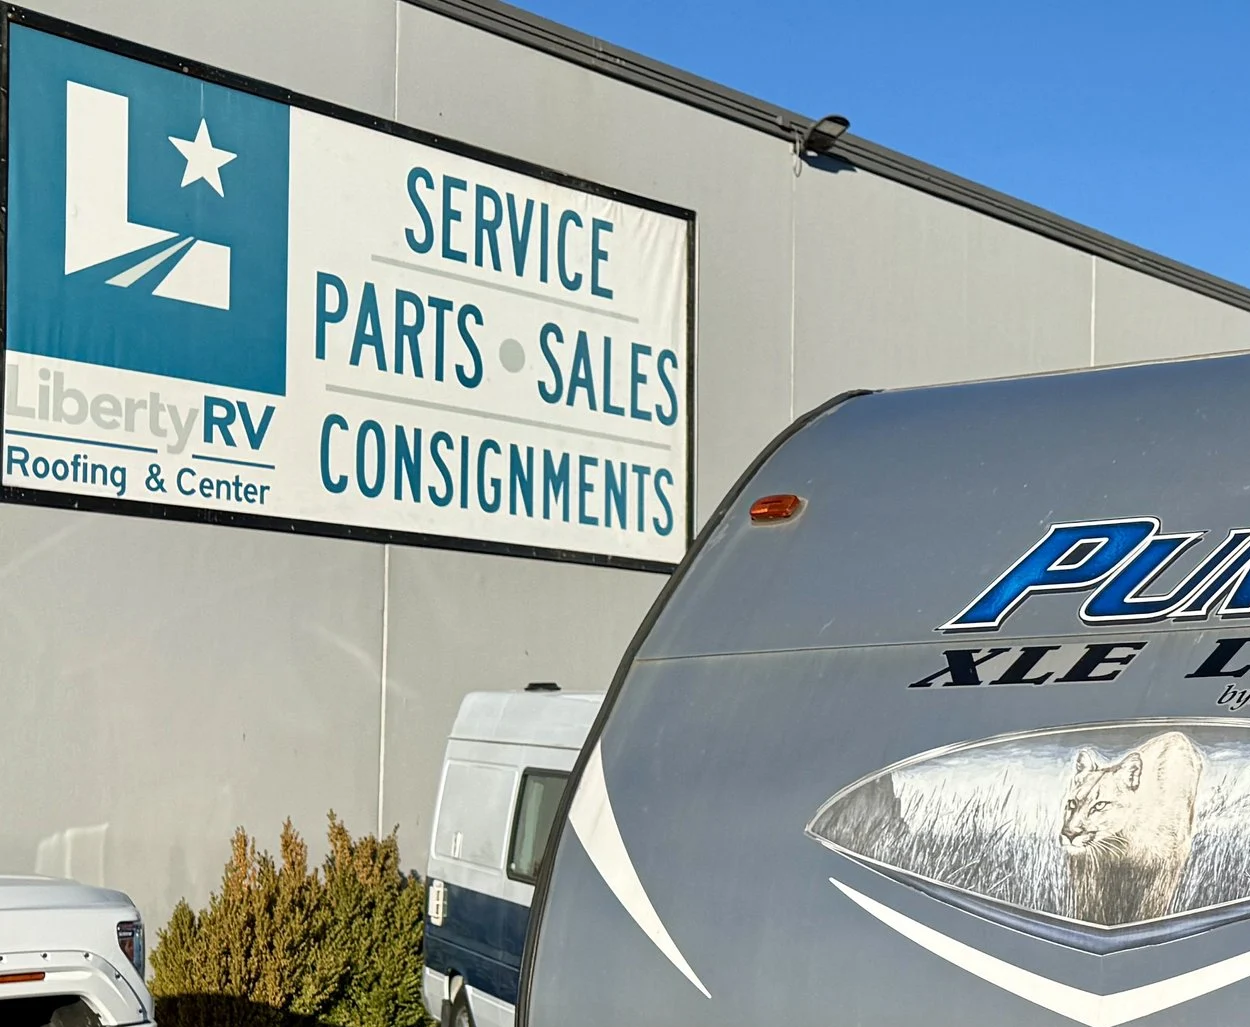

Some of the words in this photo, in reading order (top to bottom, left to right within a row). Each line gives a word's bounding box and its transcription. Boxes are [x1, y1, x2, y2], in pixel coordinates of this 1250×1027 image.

[405, 166, 614, 299] SERVICE
[315, 271, 484, 389] PARTS
[538, 322, 678, 427] SALES
[6, 445, 127, 496] Roofing
[145, 463, 168, 493] &
[177, 467, 271, 505] Center
[319, 413, 674, 536] CONSIGNMENTS
[907, 641, 1148, 689] XLE
[1217, 684, 1250, 711] by
